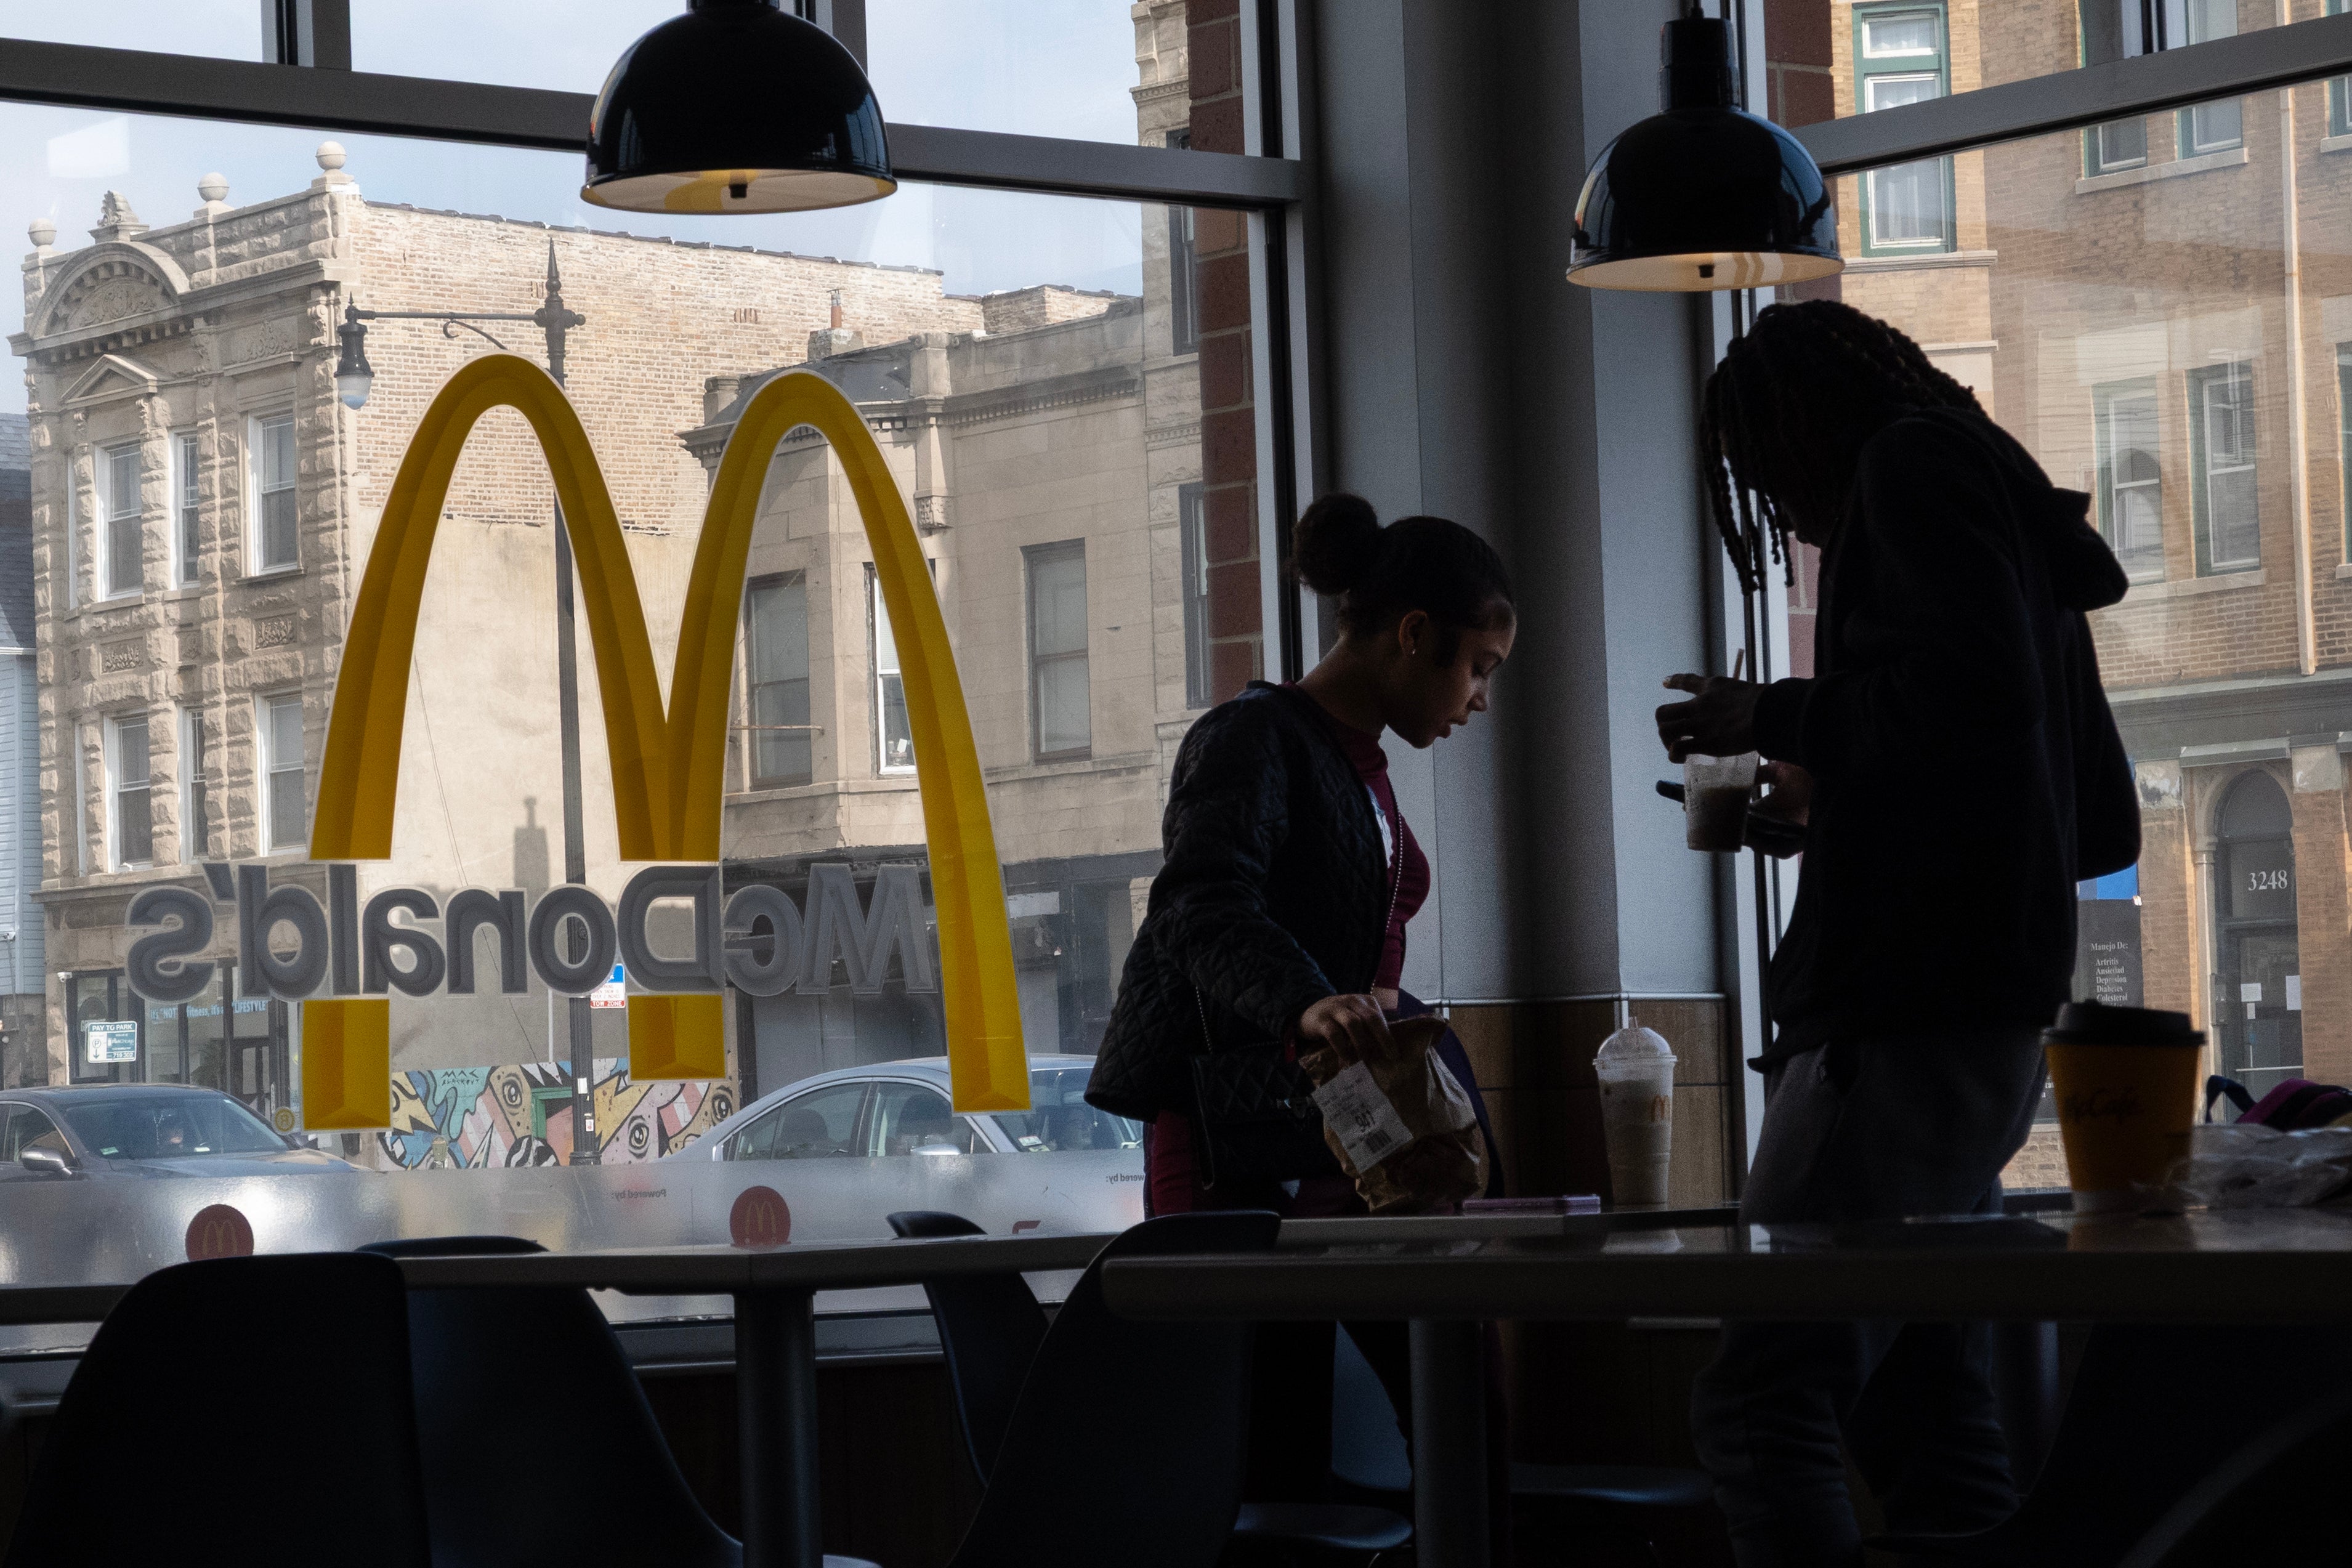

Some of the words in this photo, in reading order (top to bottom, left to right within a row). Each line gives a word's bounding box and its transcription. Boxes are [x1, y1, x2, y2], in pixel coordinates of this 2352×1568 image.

[2249, 870, 2288, 891] 3248
[2091, 942, 2116, 952] Manejo
[2096, 957, 2119, 966] Artritis
[2096, 966, 2125, 975] Ansiedad
[2096, 993, 2128, 1001] Colesterol
